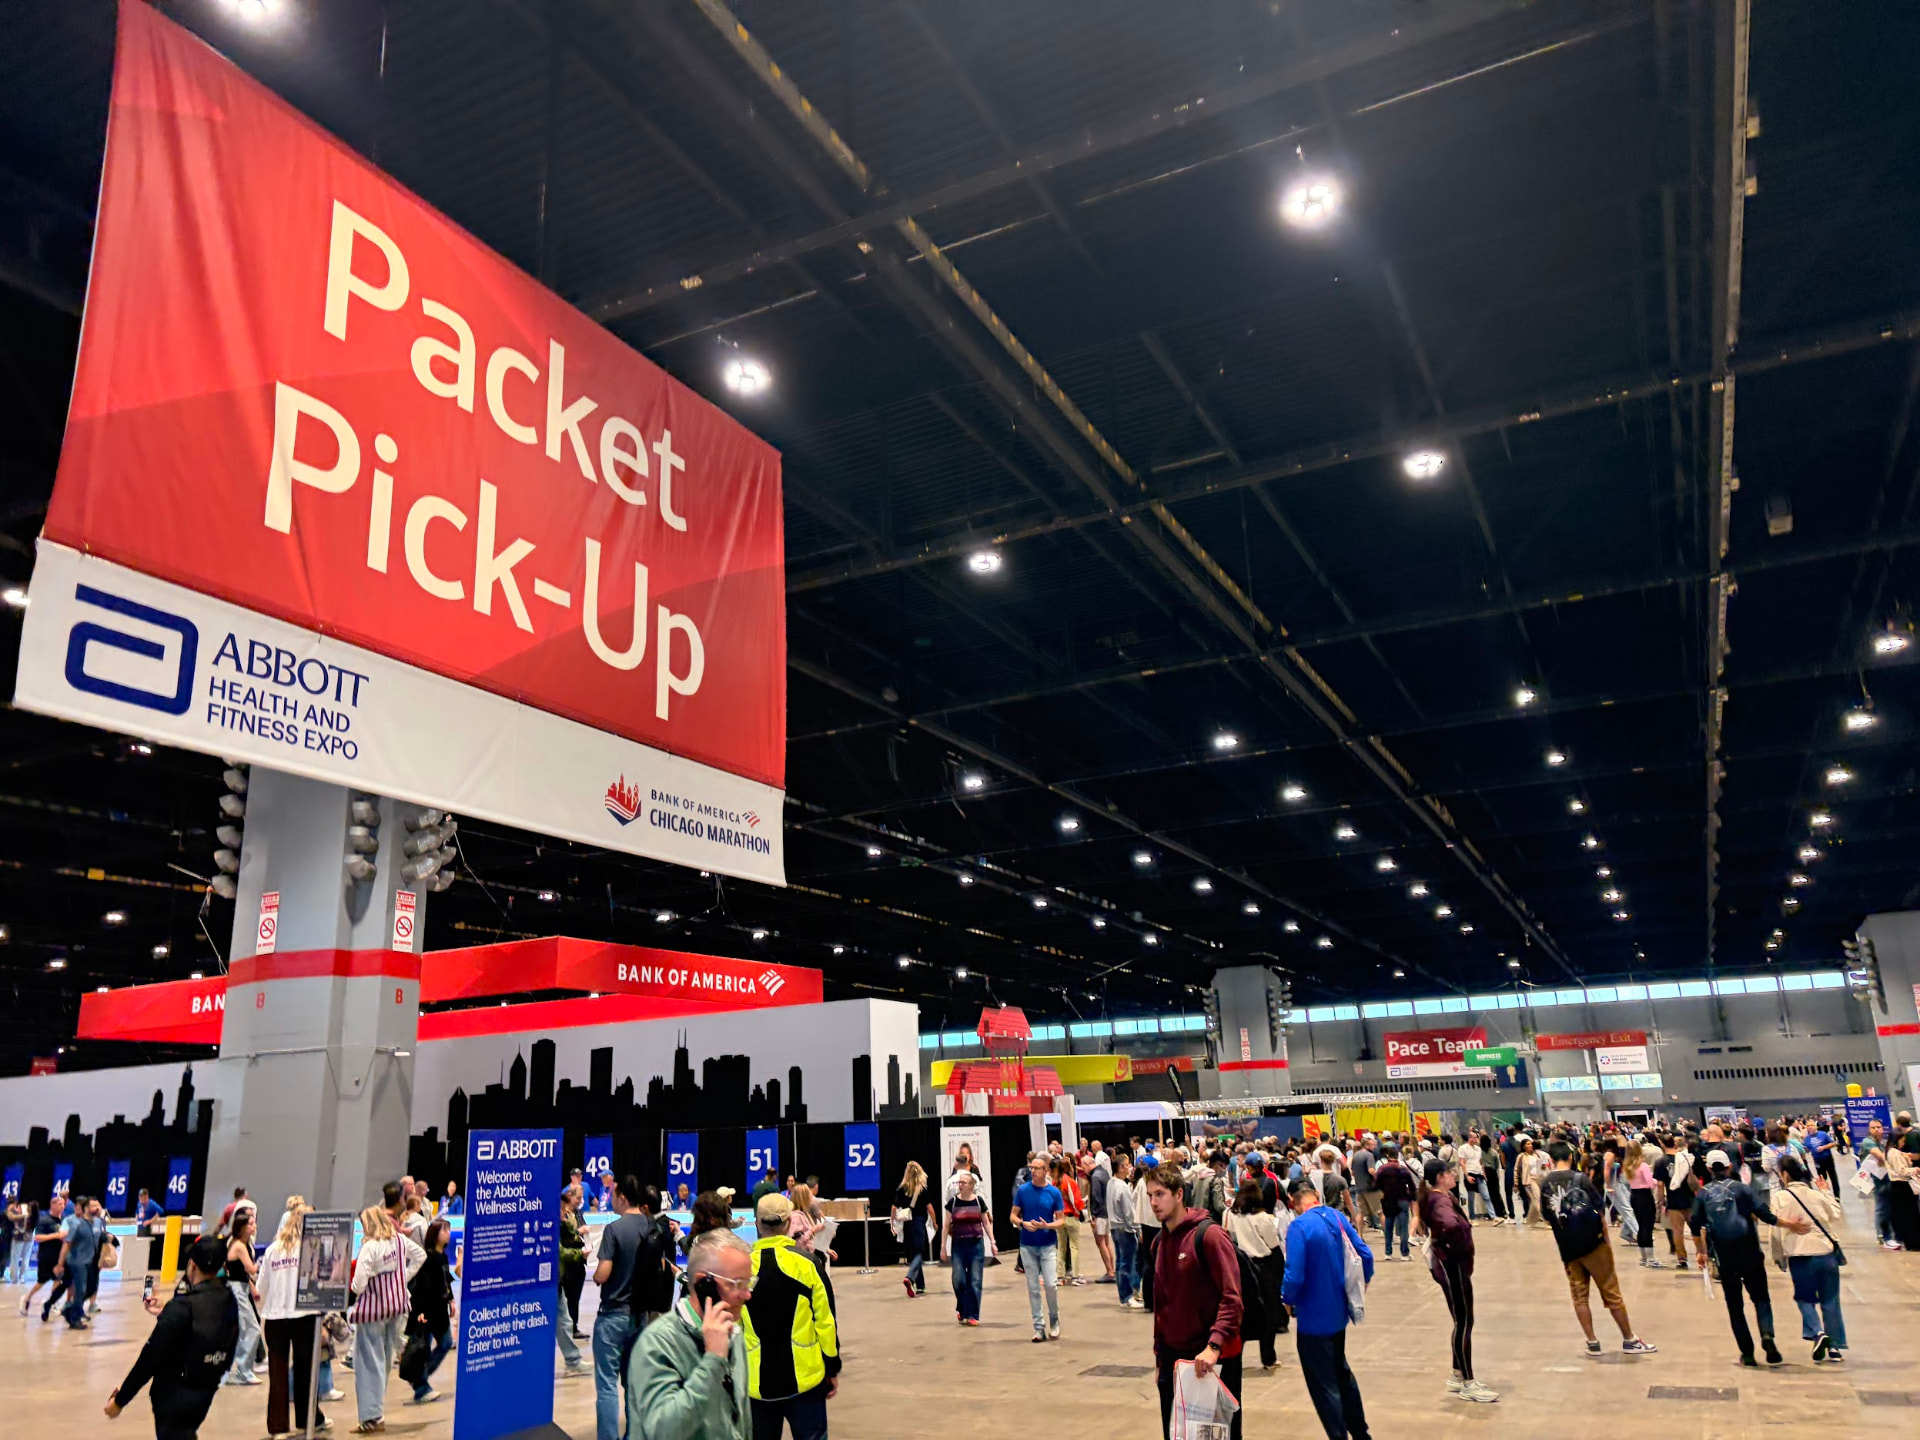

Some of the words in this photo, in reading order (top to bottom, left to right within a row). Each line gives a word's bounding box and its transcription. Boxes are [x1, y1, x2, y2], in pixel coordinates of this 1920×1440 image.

[323, 198, 688, 533] Packet
[263, 380, 706, 722] Pick-Up
[212, 632, 370, 708] ABBOTT
[208, 676, 299, 720] HEALTH
[303, 704, 351, 733] AND
[206, 702, 299, 745] FITNESS
[304, 728, 359, 761] EXPO
[651, 788, 680, 808] BANK
[682, 799, 695, 812] OF
[697, 803, 741, 825] AMERICA
[650, 808, 704, 839] CHICAGO
[707, 823, 771, 856] MARATHON
[617, 963, 664, 985] BANK
[667, 968, 688, 987] OF
[691, 971, 757, 994] AMERICA
[191, 994, 226, 1014] BAN
[1387, 1040, 1430, 1057] Pace
[1433, 1037, 1484, 1054] Team
[1550, 1035, 1606, 1047] Emergency
[1610, 1033, 1631, 1043] Exit
[1857, 1099, 1885, 1107] ABBOTT
[498, 1139, 557, 1160] ABBOTT
[749, 1148, 773, 1171] 51
[848, 1143, 876, 1167] 52
[585, 1156, 610, 1178] 49
[669, 1152, 695, 1175] 50
[107, 1176, 126, 1196] 45
[168, 1174, 188, 1194] 46
[476, 1170, 521, 1184] Welcome
[523, 1169, 532, 1182] to
[2, 1180, 19, 1198] 43
[53, 1179, 70, 1198] 44
[476, 1186, 492, 1200] the
[493, 1184, 527, 1199] Abbott
[475, 1200, 517, 1215] Wellness
[519, 1197, 543, 1212] Dash
[469, 1307, 500, 1323] Collect
[501, 1303, 511, 1318] all
[512, 1302, 519, 1315] 6
[520, 1301, 542, 1314] stars.
[468, 1321, 511, 1339] Complete
[512, 1317, 526, 1331] the
[527, 1313, 549, 1328] dash.
[467, 1339, 491, 1355] Enter
[492, 1338, 502, 1350] to
[502, 1333, 520, 1347] win.
